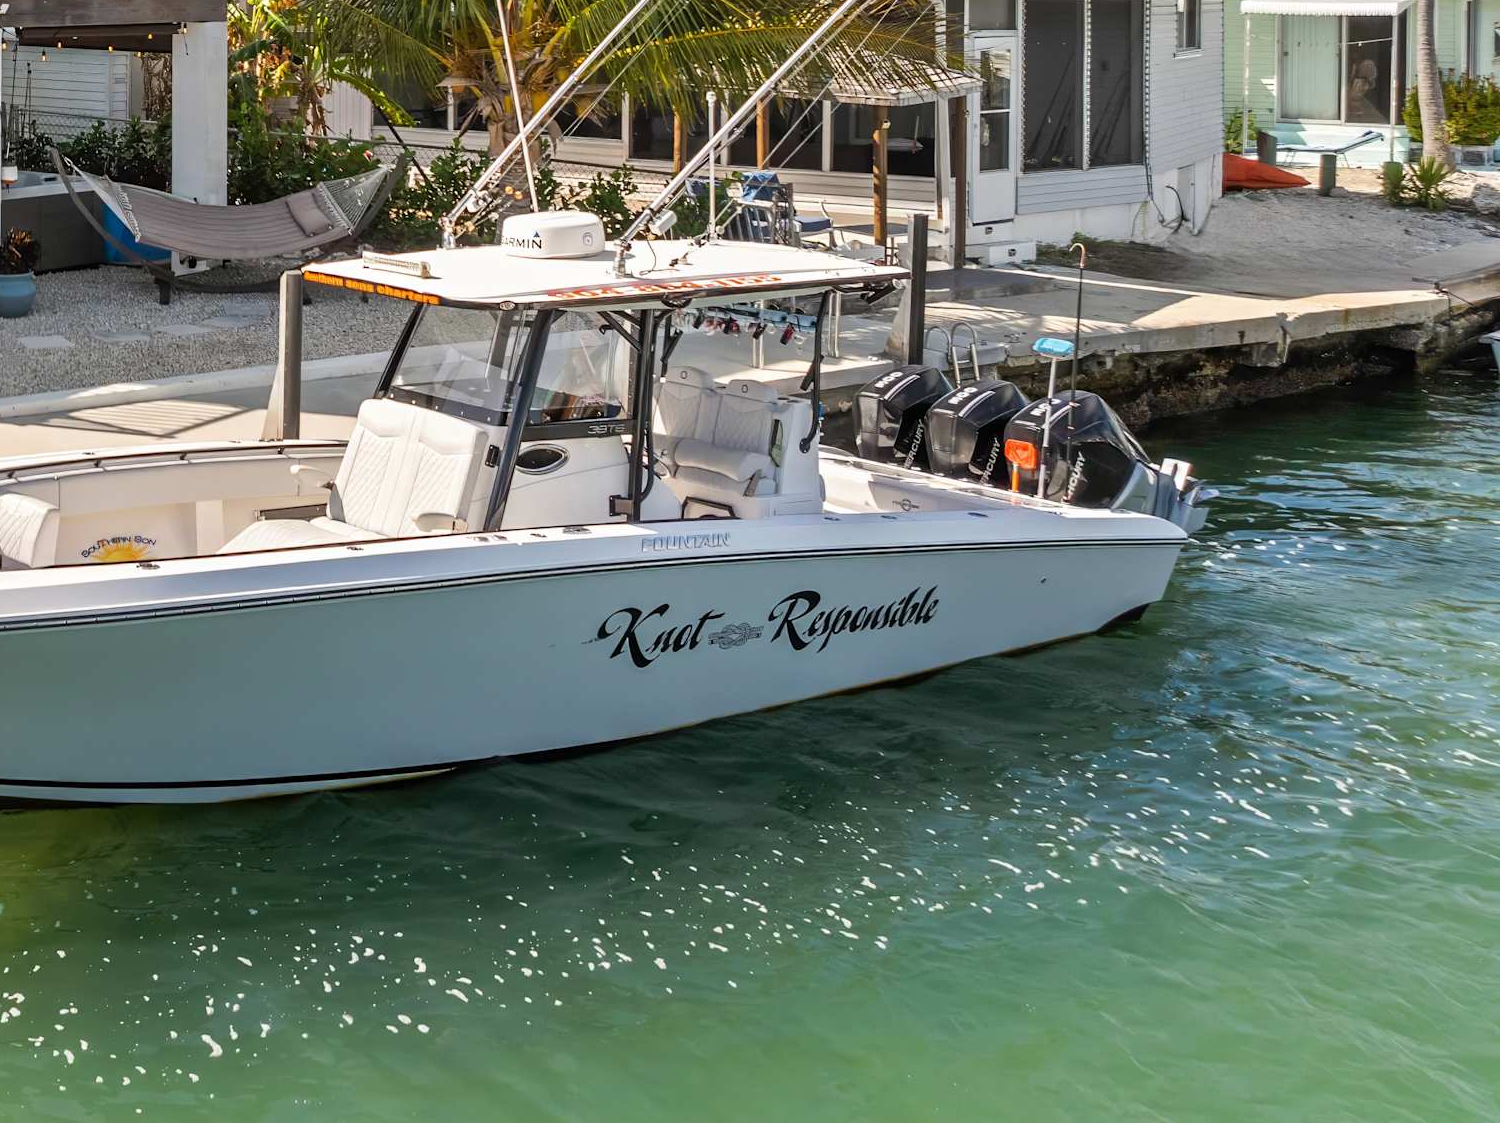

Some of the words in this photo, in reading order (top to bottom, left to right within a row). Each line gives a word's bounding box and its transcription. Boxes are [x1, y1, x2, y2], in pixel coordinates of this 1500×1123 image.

[134, 535, 157, 546] SON
[594, 603, 726, 669] Knot
[767, 584, 940, 654] Responsible
